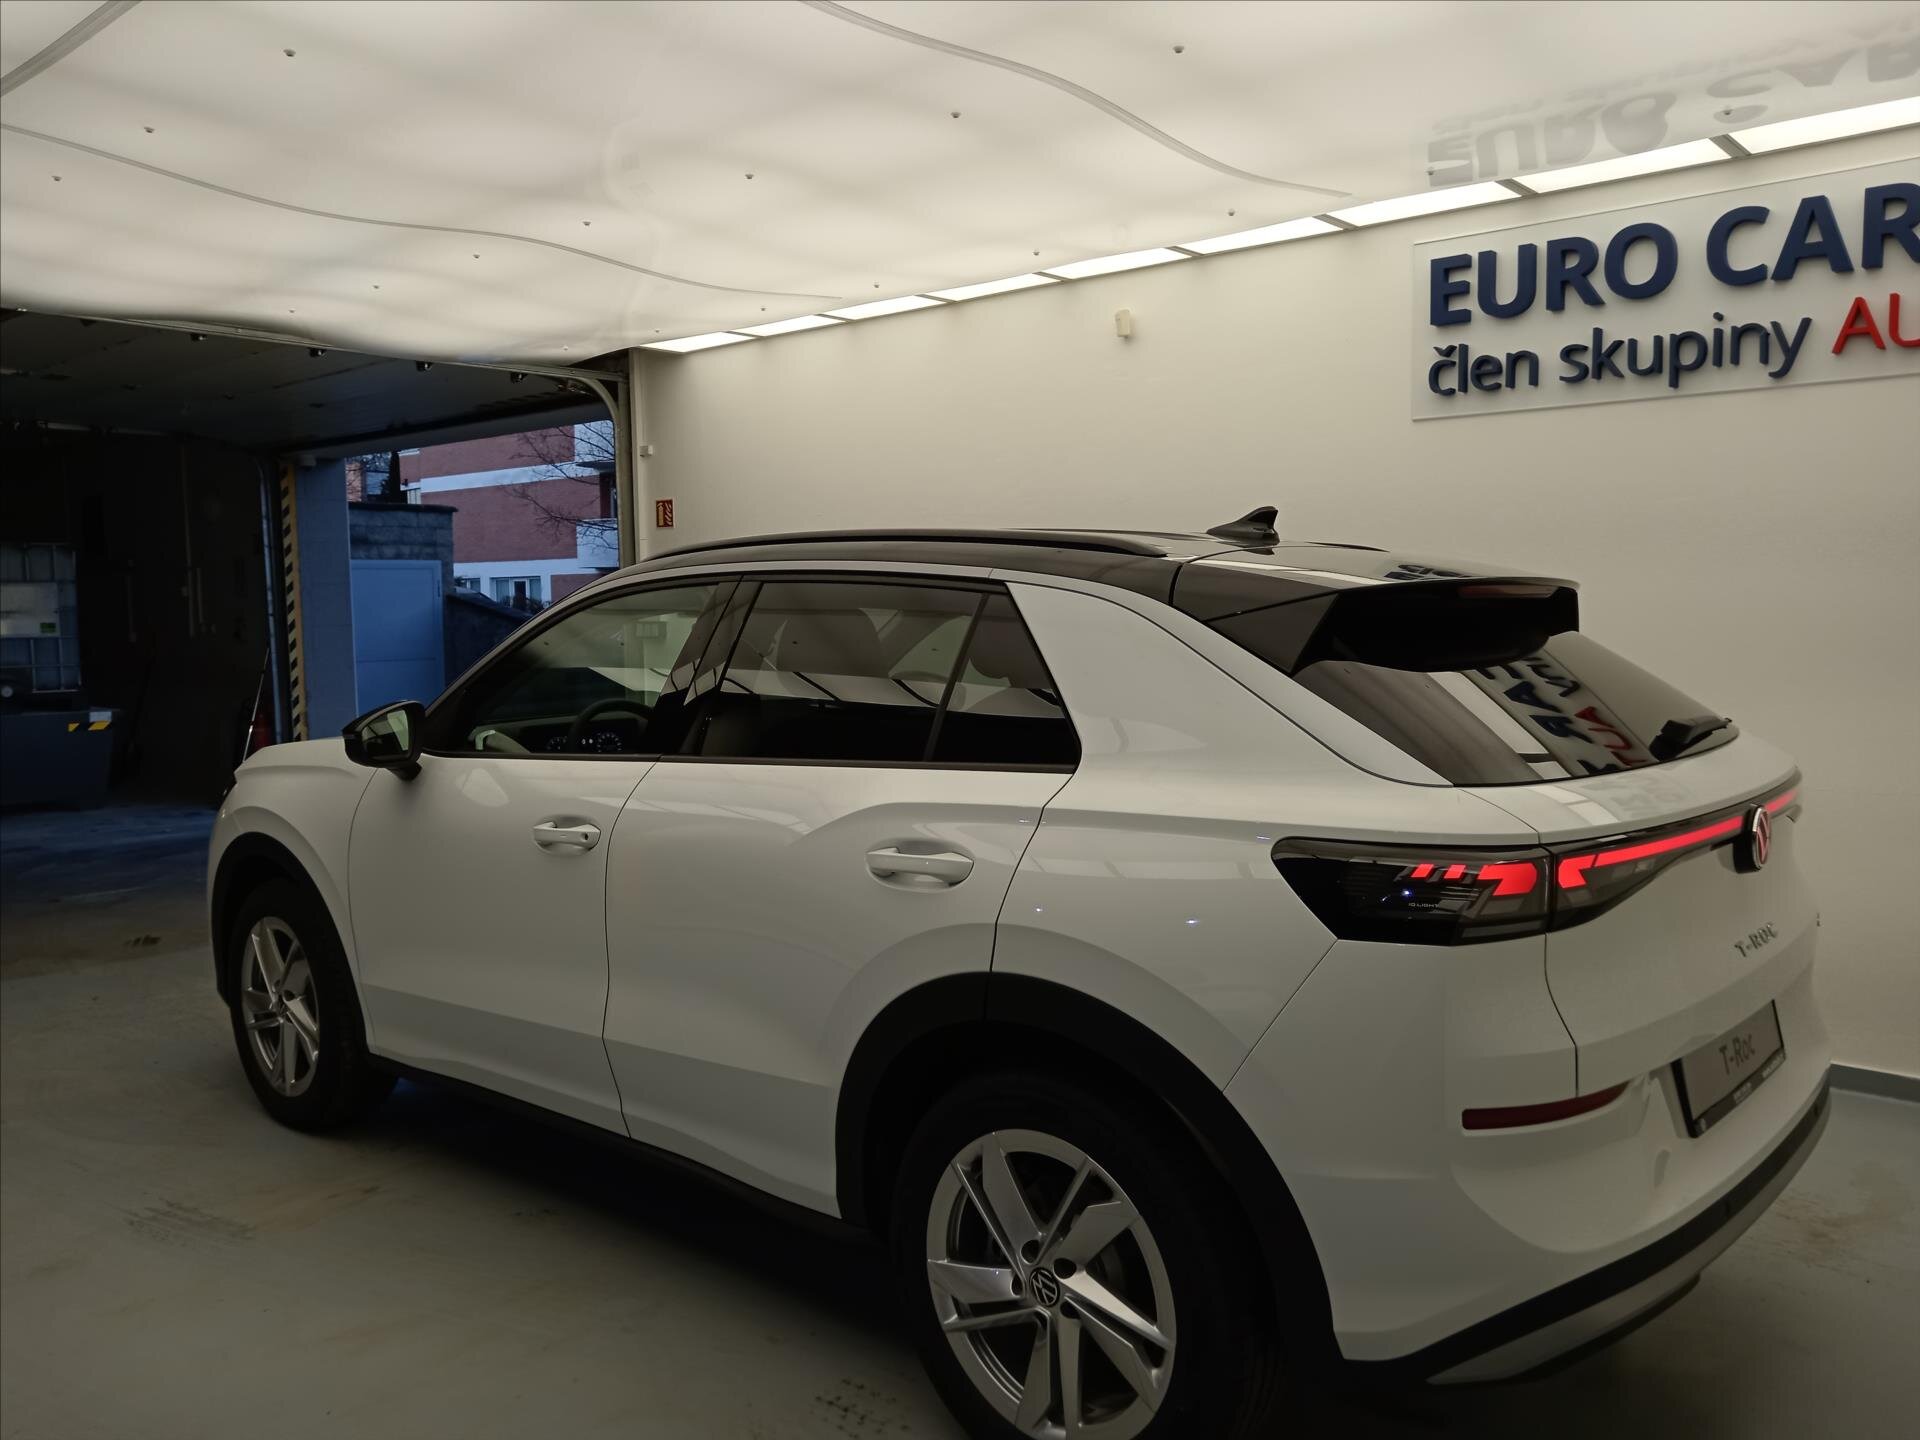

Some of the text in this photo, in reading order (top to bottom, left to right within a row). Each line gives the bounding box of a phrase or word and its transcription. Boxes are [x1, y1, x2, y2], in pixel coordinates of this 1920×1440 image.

[1429, 182, 1920, 328] EURO CAR
[1428, 343, 1540, 397] člen
[1559, 312, 1812, 389] skupiny
